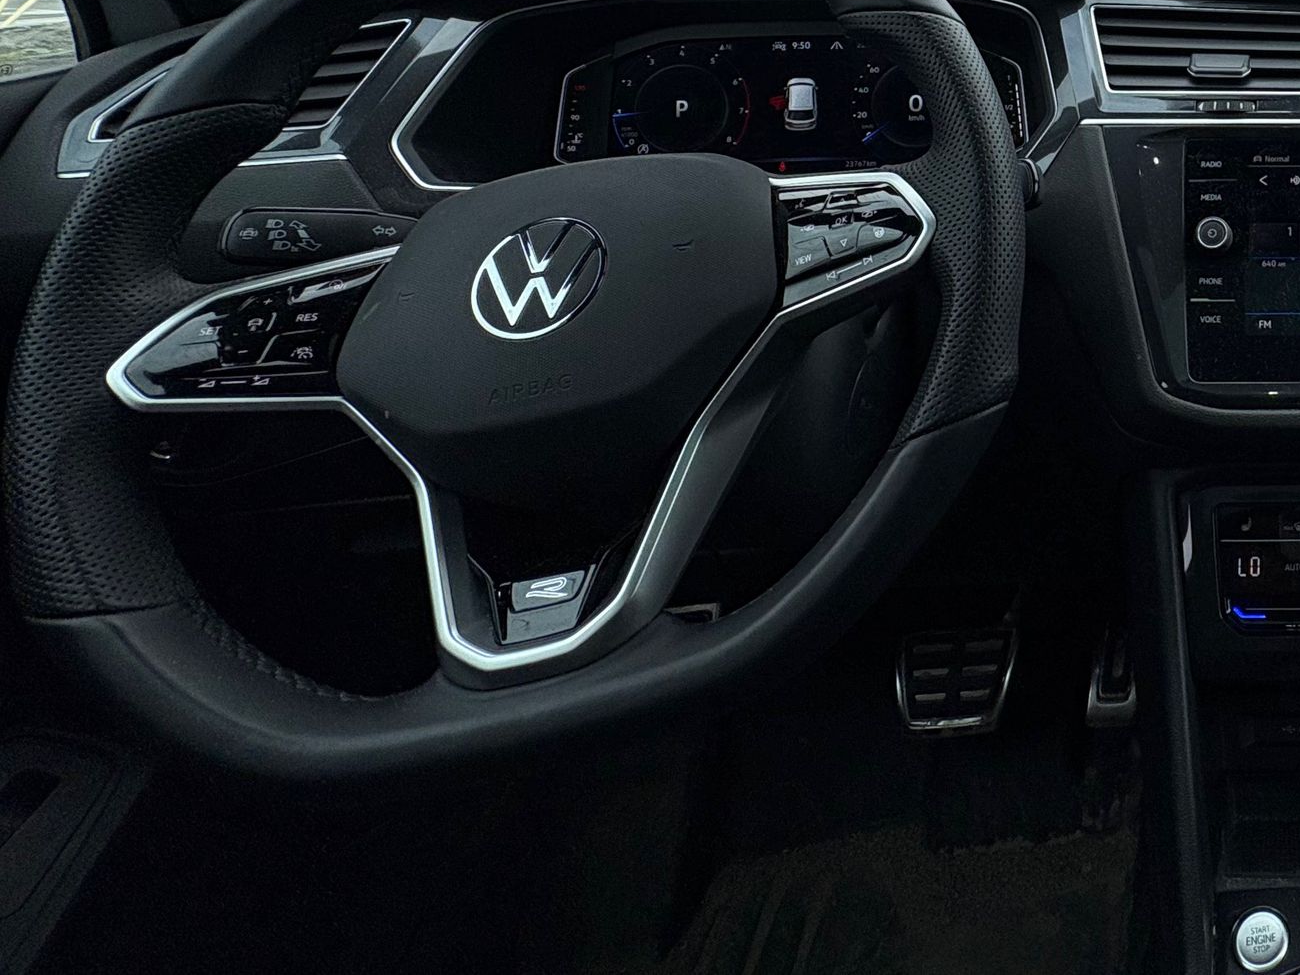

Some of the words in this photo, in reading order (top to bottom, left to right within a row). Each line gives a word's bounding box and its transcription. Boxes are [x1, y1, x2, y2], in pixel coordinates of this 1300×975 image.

[792, 41, 811, 50] 9:50
[869, 66, 880, 74] 60
[626, 79, 633, 87] 2
[731, 78, 739, 86] 6
[908, 94, 923, 112] 0
[675, 99, 689, 118] P
[1200, 160, 1222, 168] RADIO
[1265, 155, 1290, 163] Normal
[1200, 193, 1222, 201] MEDIA
[835, 215, 848, 225] OK
[1287, 226, 1293, 237] 1
[794, 253, 812, 266] VIEW
[1261, 259, 1277, 267] 640
[1199, 277, 1223, 285] PHONE
[296, 313, 318, 323] RES
[1200, 315, 1221, 324] VOICE
[1258, 319, 1272, 329] FM
[200, 326, 222, 336] SET
[488, 373, 573, 405] AIRBAG
[1237, 555, 1261, 577] LO
[1250, 925, 1270, 935] START
[1245, 932, 1276, 946] ENGINE
[1253, 944, 1271, 954] STOP
